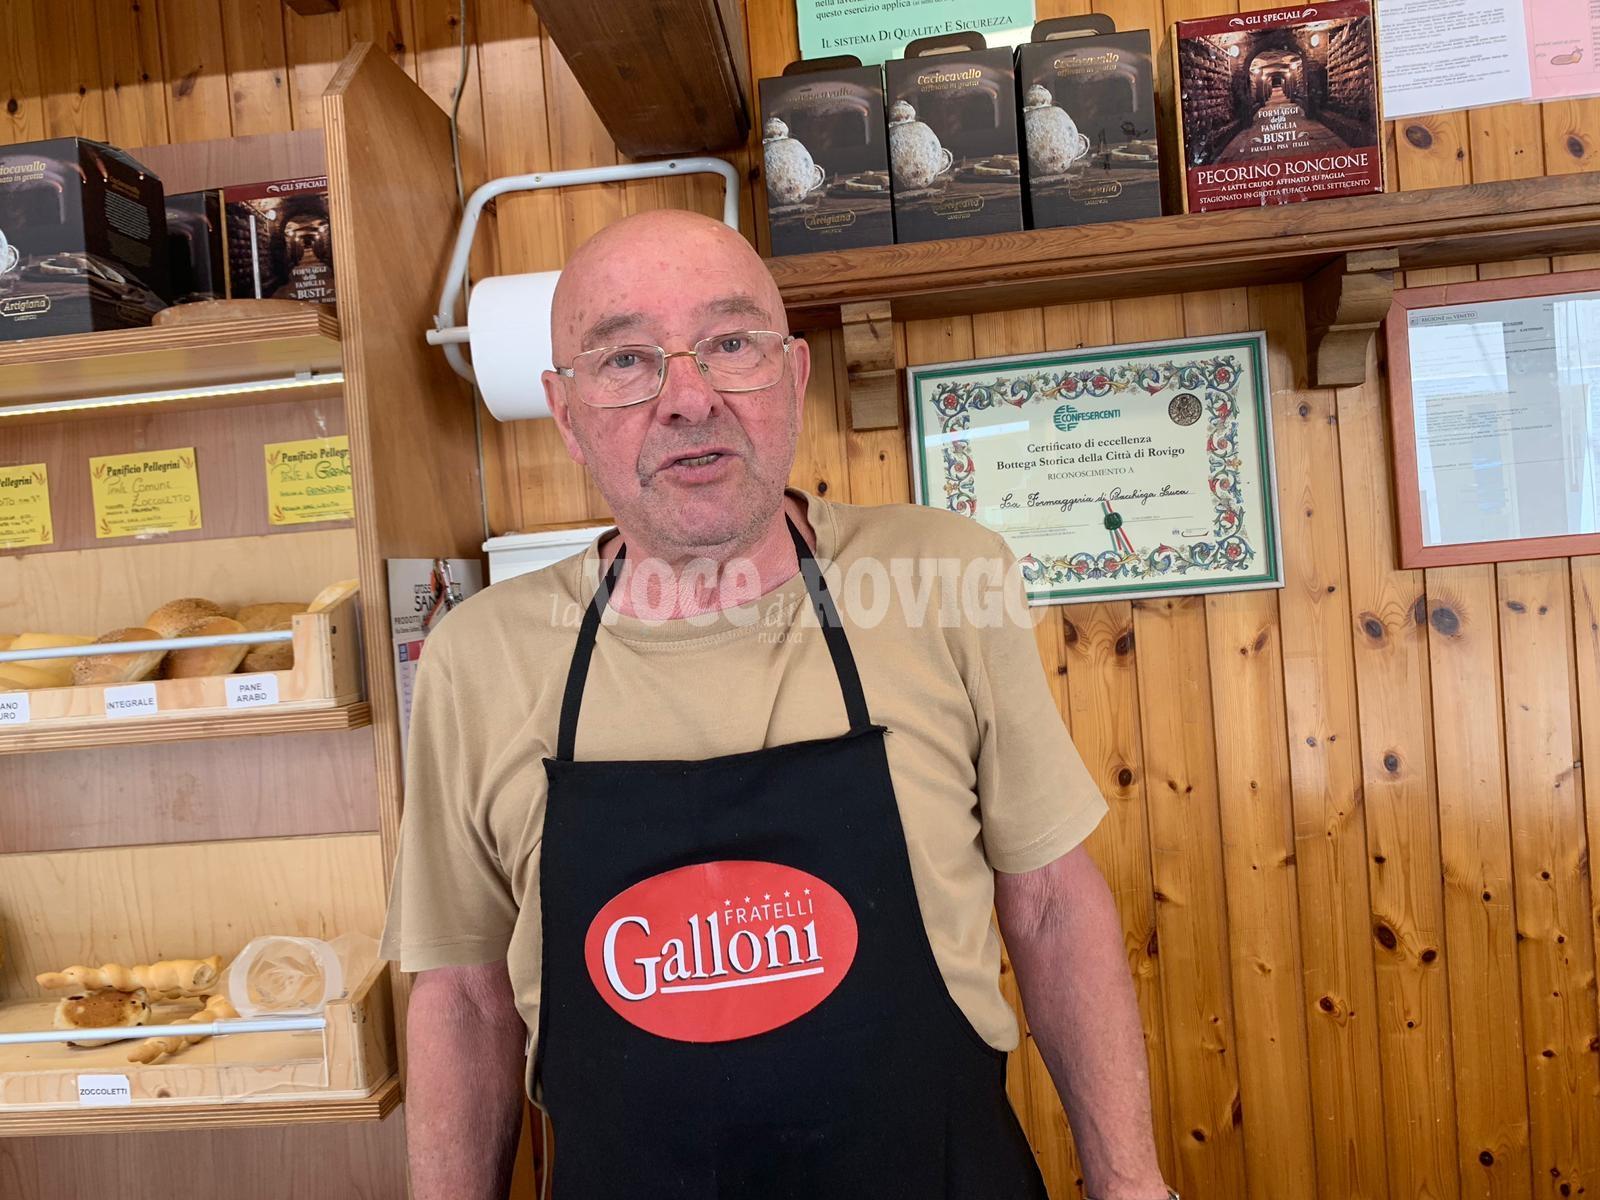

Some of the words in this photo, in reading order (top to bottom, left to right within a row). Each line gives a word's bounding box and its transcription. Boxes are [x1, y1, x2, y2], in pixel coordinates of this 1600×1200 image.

[816, 10, 842, 21] questo
[844, 4, 880, 15] esercizio
[882, 0, 911, 11] applica
[1245, 16, 1261, 25] GLI
[1263, 10, 1301, 22] SPECIALI
[945, 22, 953, 32] E
[917, 68, 982, 85] Caciocavallo
[1258, 106, 1299, 119] FORMAGGI
[1270, 115, 1287, 124] della
[1261, 121, 1298, 132] FAMIGLIA
[1262, 130, 1297, 144] BUSTI
[1251, 145, 1274, 153] FAUGLIA
[1292, 141, 1310, 149] ITALIA
[1197, 163, 1281, 185] PECORINO
[1285, 153, 1369, 175] RONCIONE
[280, 183, 294, 192] GLI
[295, 179, 327, 190] SPECIALI
[1228, 183, 1247, 192] LATTE
[1248, 180, 1274, 189] CRUDO
[1276, 176, 1310, 186] AFFINATO
[1321, 172, 1346, 181] PAGLIA
[1200, 193, 1243, 204] STAGIONATO
[1253, 188, 1281, 199] GROTTA
[1282, 186, 1312, 195] TUFACEA
[1312, 184, 1326, 192] DEL
[1327, 178, 1371, 190] SETTECENTO
[297, 287, 326, 300] BUSTI
[1061, 409, 1121, 423] CONFESERCENTI
[1027, 441, 1082, 453] Certificato
[1084, 438, 1095, 448] di
[1097, 435, 1153, 447] eccellenza
[282, 450, 318, 464] Panificio
[996, 459, 1037, 471] Bottega
[1039, 456, 1075, 467] Storica
[1077, 453, 1104, 464] della
[1105, 449, 1132, 461] Città
[1134, 448, 1145, 458] di
[1147, 446, 1186, 458] Rovigo
[106, 464, 142, 477] Panificio
[143, 459, 181, 473] Pellegrini
[1047, 467, 1127, 481] RICONOSCIMENTO
[1127, 466, 1136, 474] A
[0, 476, 32, 488] ellegrini
[1000, 493, 1021, 509] La
[1027, 491, 1094, 513] Formaggeria
[1159, 484, 1190, 498] Luca
[239, 682, 263, 692] PANE
[106, 697, 155, 710] INTEGRALE
[236, 692, 268, 702] ARABO
[723, 898, 814, 926] FRATELLI
[602, 911, 823, 1001] Galloni
[79, 1087, 128, 1097] ZOCCOLETTI
